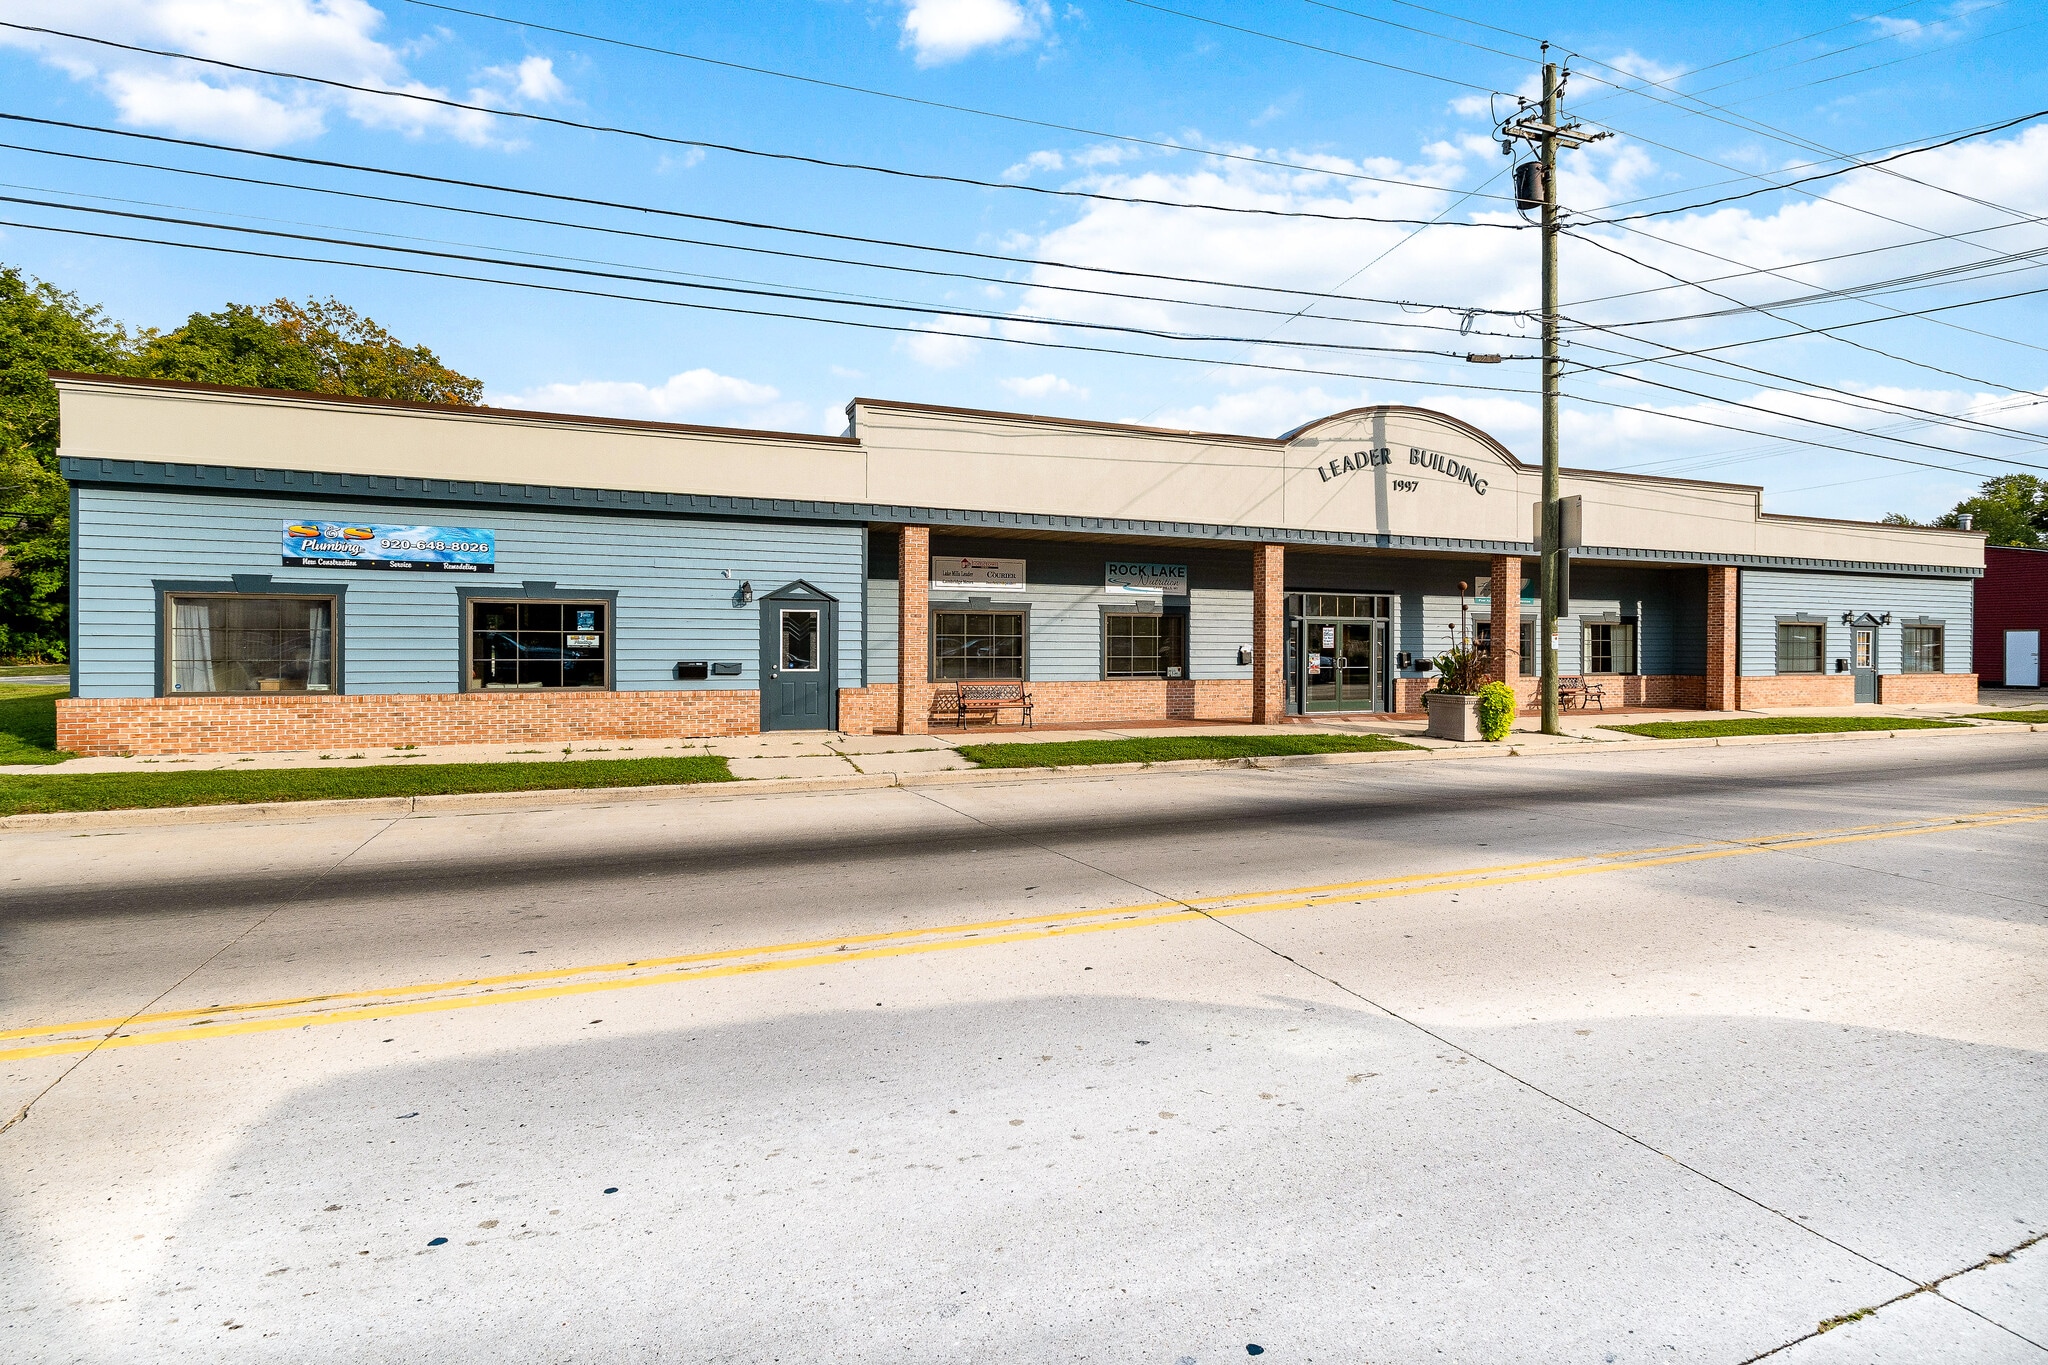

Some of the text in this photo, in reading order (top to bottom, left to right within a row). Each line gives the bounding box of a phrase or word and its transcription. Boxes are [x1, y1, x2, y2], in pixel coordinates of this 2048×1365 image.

[1318, 447, 1489, 496] LEADER BUILDING
[1392, 480, 1419, 493] 1997
[324, 525, 341, 539] &
[301, 539, 360, 556] Plumbing
[380, 538, 490, 552] 920-648-8026
[318, 558, 357, 566] Construction
[389, 560, 412, 569] Service
[443, 562, 477, 571] Remodeling
[986, 571, 1016, 579] COURIER
[1109, 564, 1185, 578] ROCK LAKE
[1135, 575, 1179, 587] Nutrition
